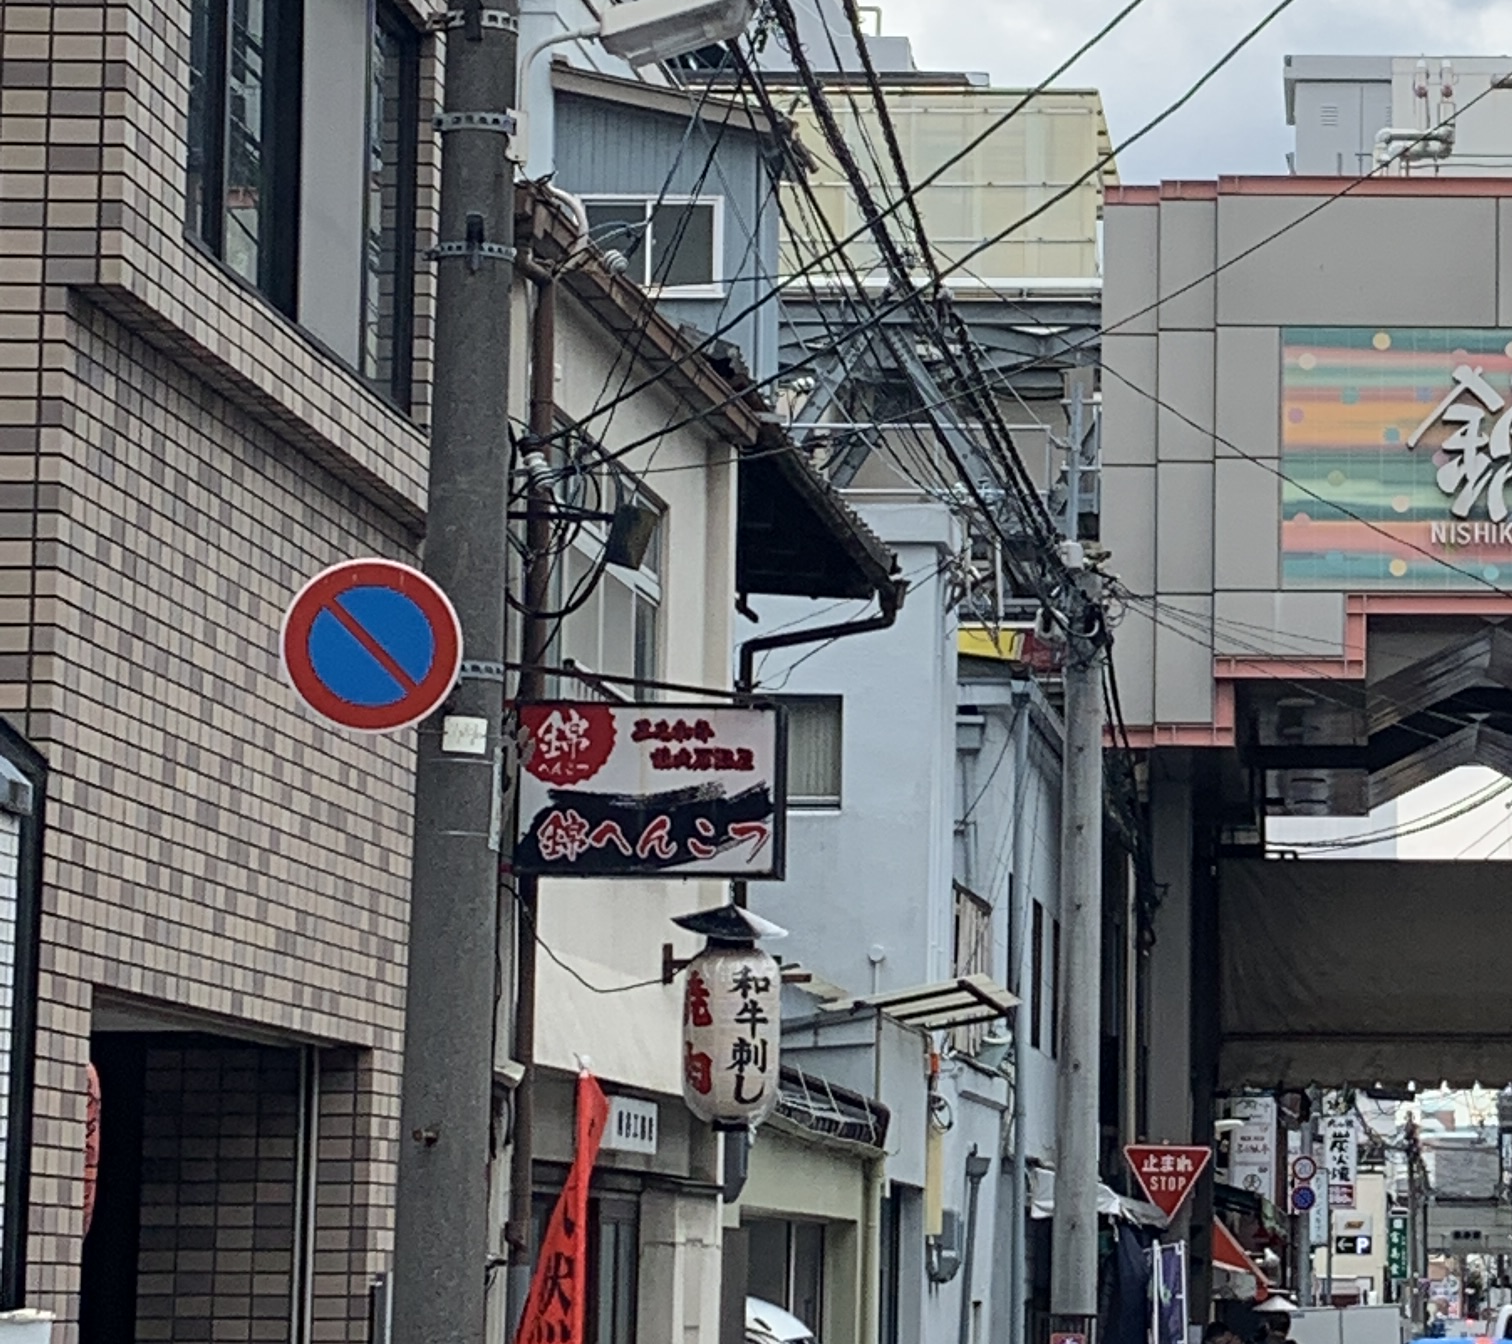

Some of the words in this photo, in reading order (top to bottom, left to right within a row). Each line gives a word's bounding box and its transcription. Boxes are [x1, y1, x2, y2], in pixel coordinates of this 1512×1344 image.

[537, 708, 591, 760] 錦
[536, 808, 771, 864] 錦へんこつ
[726, 964, 771, 1105] 和牛刺し
[1141, 1154, 1194, 1173] 止まれ
[1150, 1176, 1186, 1192] STOP
[1356, 1237, 1370, 1254] P
